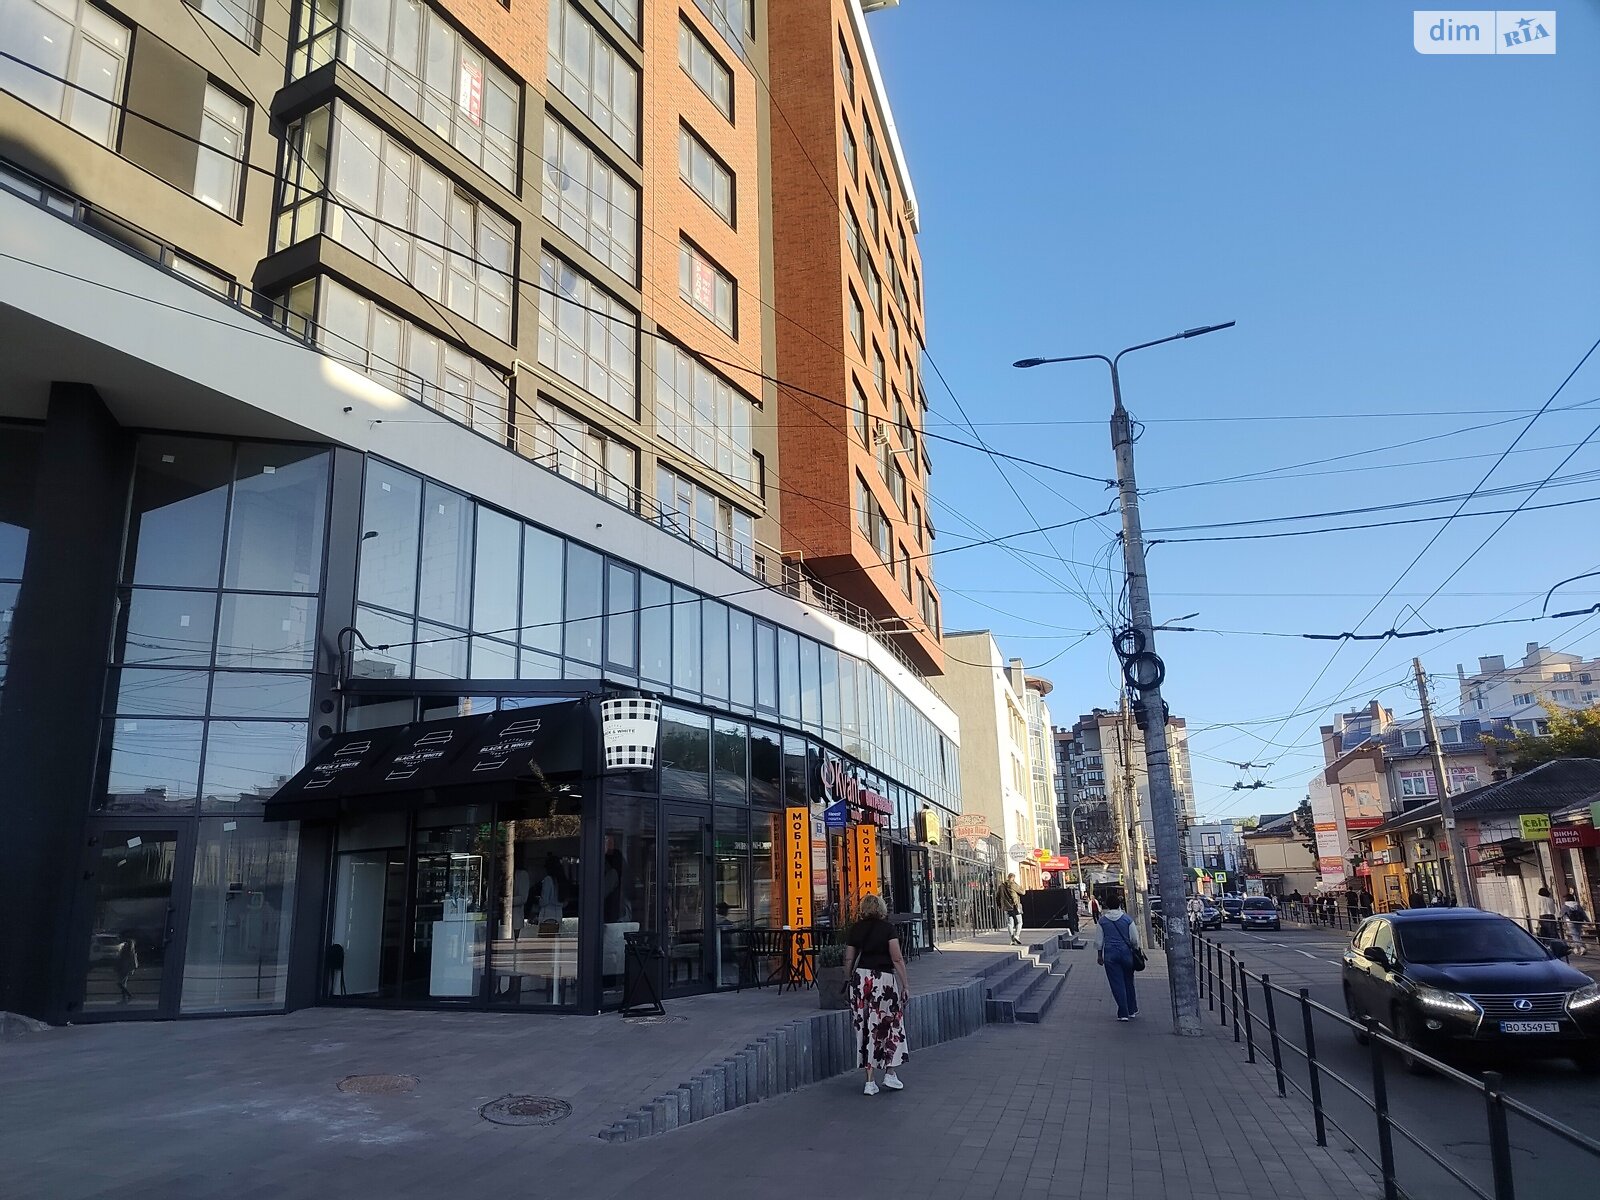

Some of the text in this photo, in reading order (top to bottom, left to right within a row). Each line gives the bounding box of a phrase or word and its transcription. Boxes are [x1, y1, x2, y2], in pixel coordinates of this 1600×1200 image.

[479, 744, 503, 753] BLACK
[510, 740, 534, 748] WHITE
[792, 812, 803, 890] МОБІЛЬНІ
[862, 828, 871, 872] ЧОХЛИ
